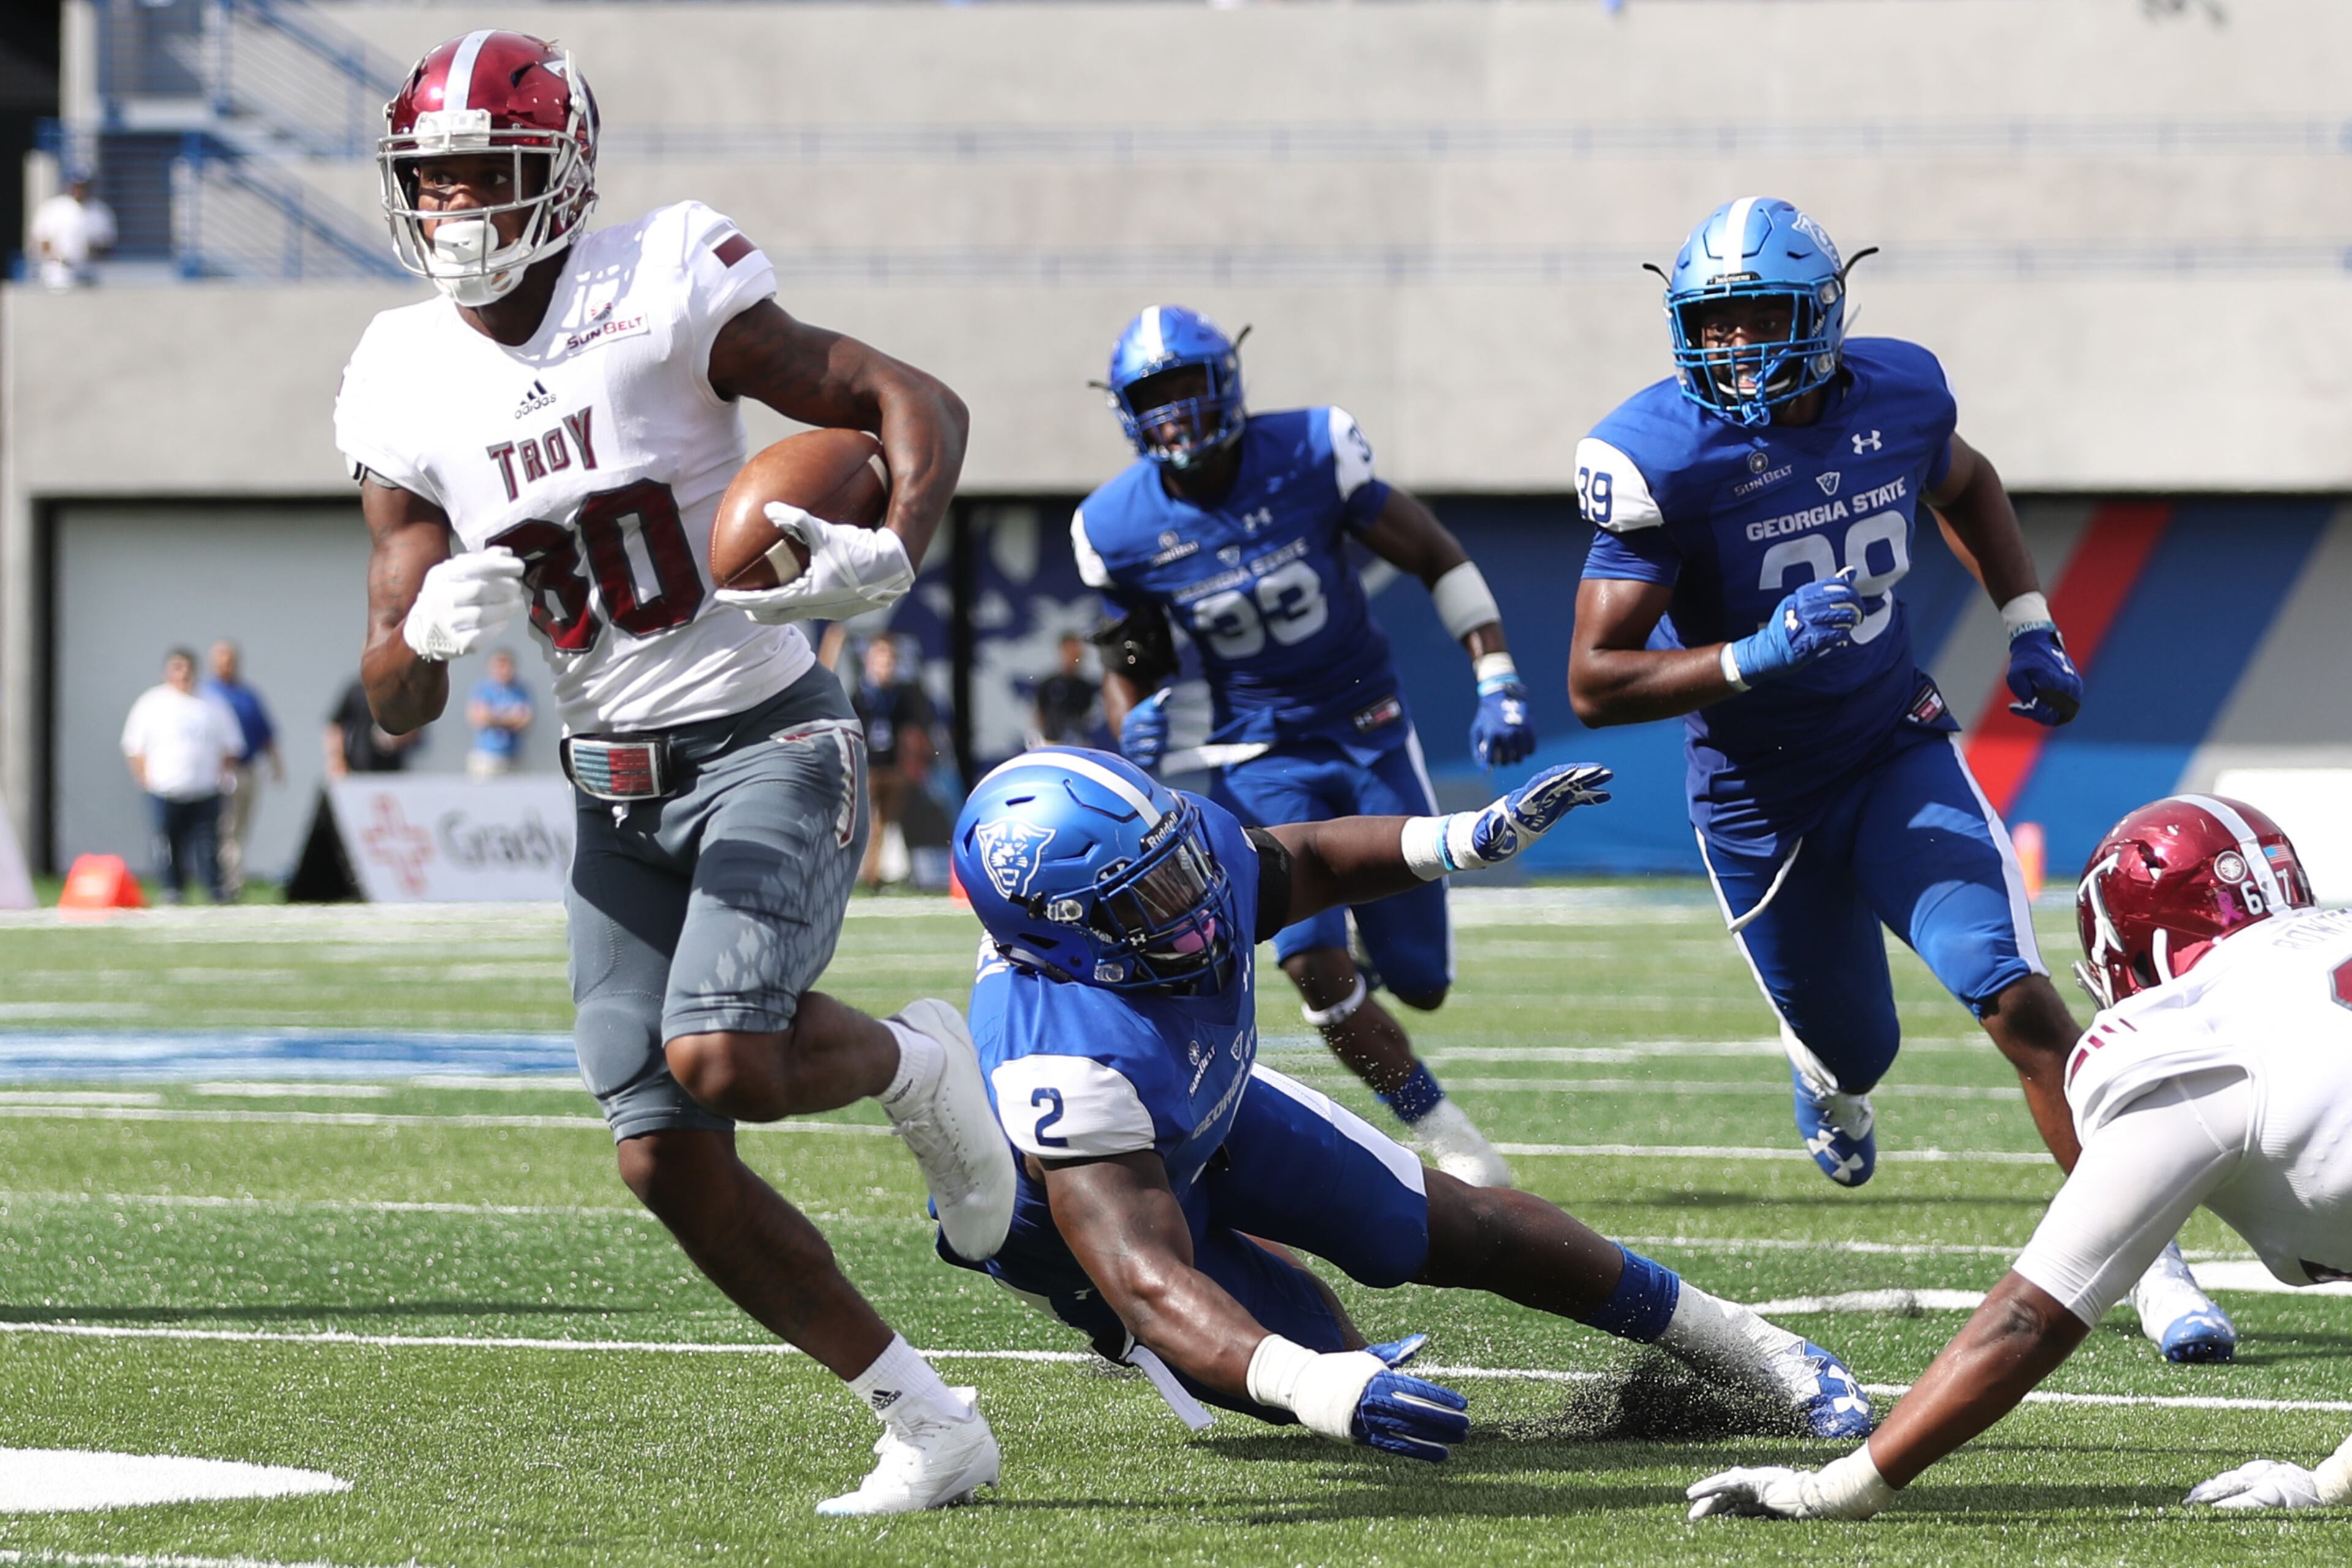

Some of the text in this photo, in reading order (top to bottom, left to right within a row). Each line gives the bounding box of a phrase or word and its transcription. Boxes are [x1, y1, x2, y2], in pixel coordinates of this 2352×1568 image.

[514, 393, 557, 420] adidas
[486, 405, 598, 502] TROY
[1579, 466, 1613, 524] 39
[1746, 476, 1907, 541] GEORGIA STATE
[484, 477, 706, 654] 80
[1193, 558, 1329, 660] 33
[1031, 1087, 1068, 1147] 2
